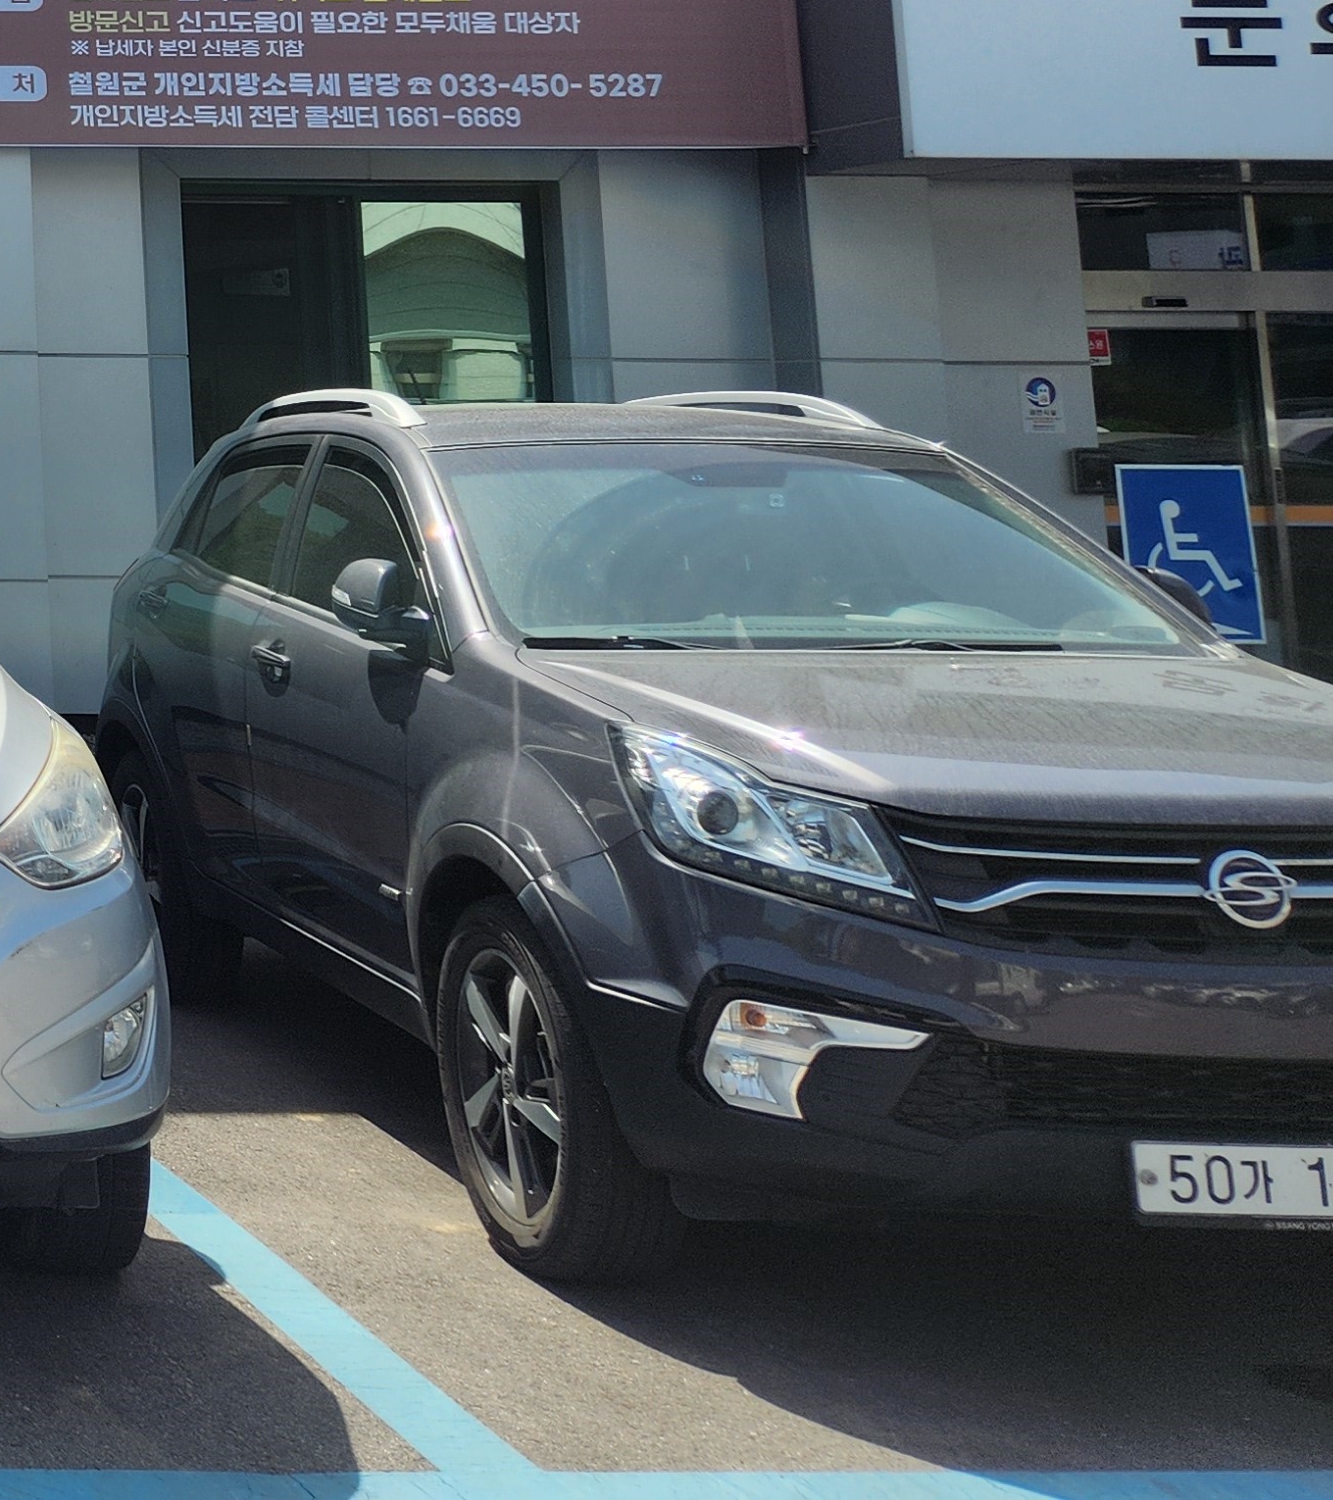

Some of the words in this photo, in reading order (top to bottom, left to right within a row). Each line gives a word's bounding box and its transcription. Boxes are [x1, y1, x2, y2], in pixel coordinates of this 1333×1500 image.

[68, 10, 171, 33] 방문신고
[176, 10, 304, 34] 신고도움이
[310, 10, 388, 34] 필요한
[395, 11, 497, 34] 모두채움
[504, 11, 581, 34] 대상자
[95, 39, 154, 57] 납세자
[158, 39, 197, 57] 본인
[201, 39, 261, 57] 신분증
[265, 39, 304, 57] 지참
[68, 71, 147, 96] 철원군
[153, 71, 341, 97] 개인지방소득세
[347, 72, 401, 98] 담당
[69, 104, 242, 128] 개인지방소득세
[249, 105, 298, 129] 전담
[304, 105, 379, 129] 콜센터
[385, 105, 522, 129] 1661-6669
[1169, 1154, 1275, 1205] 50가
